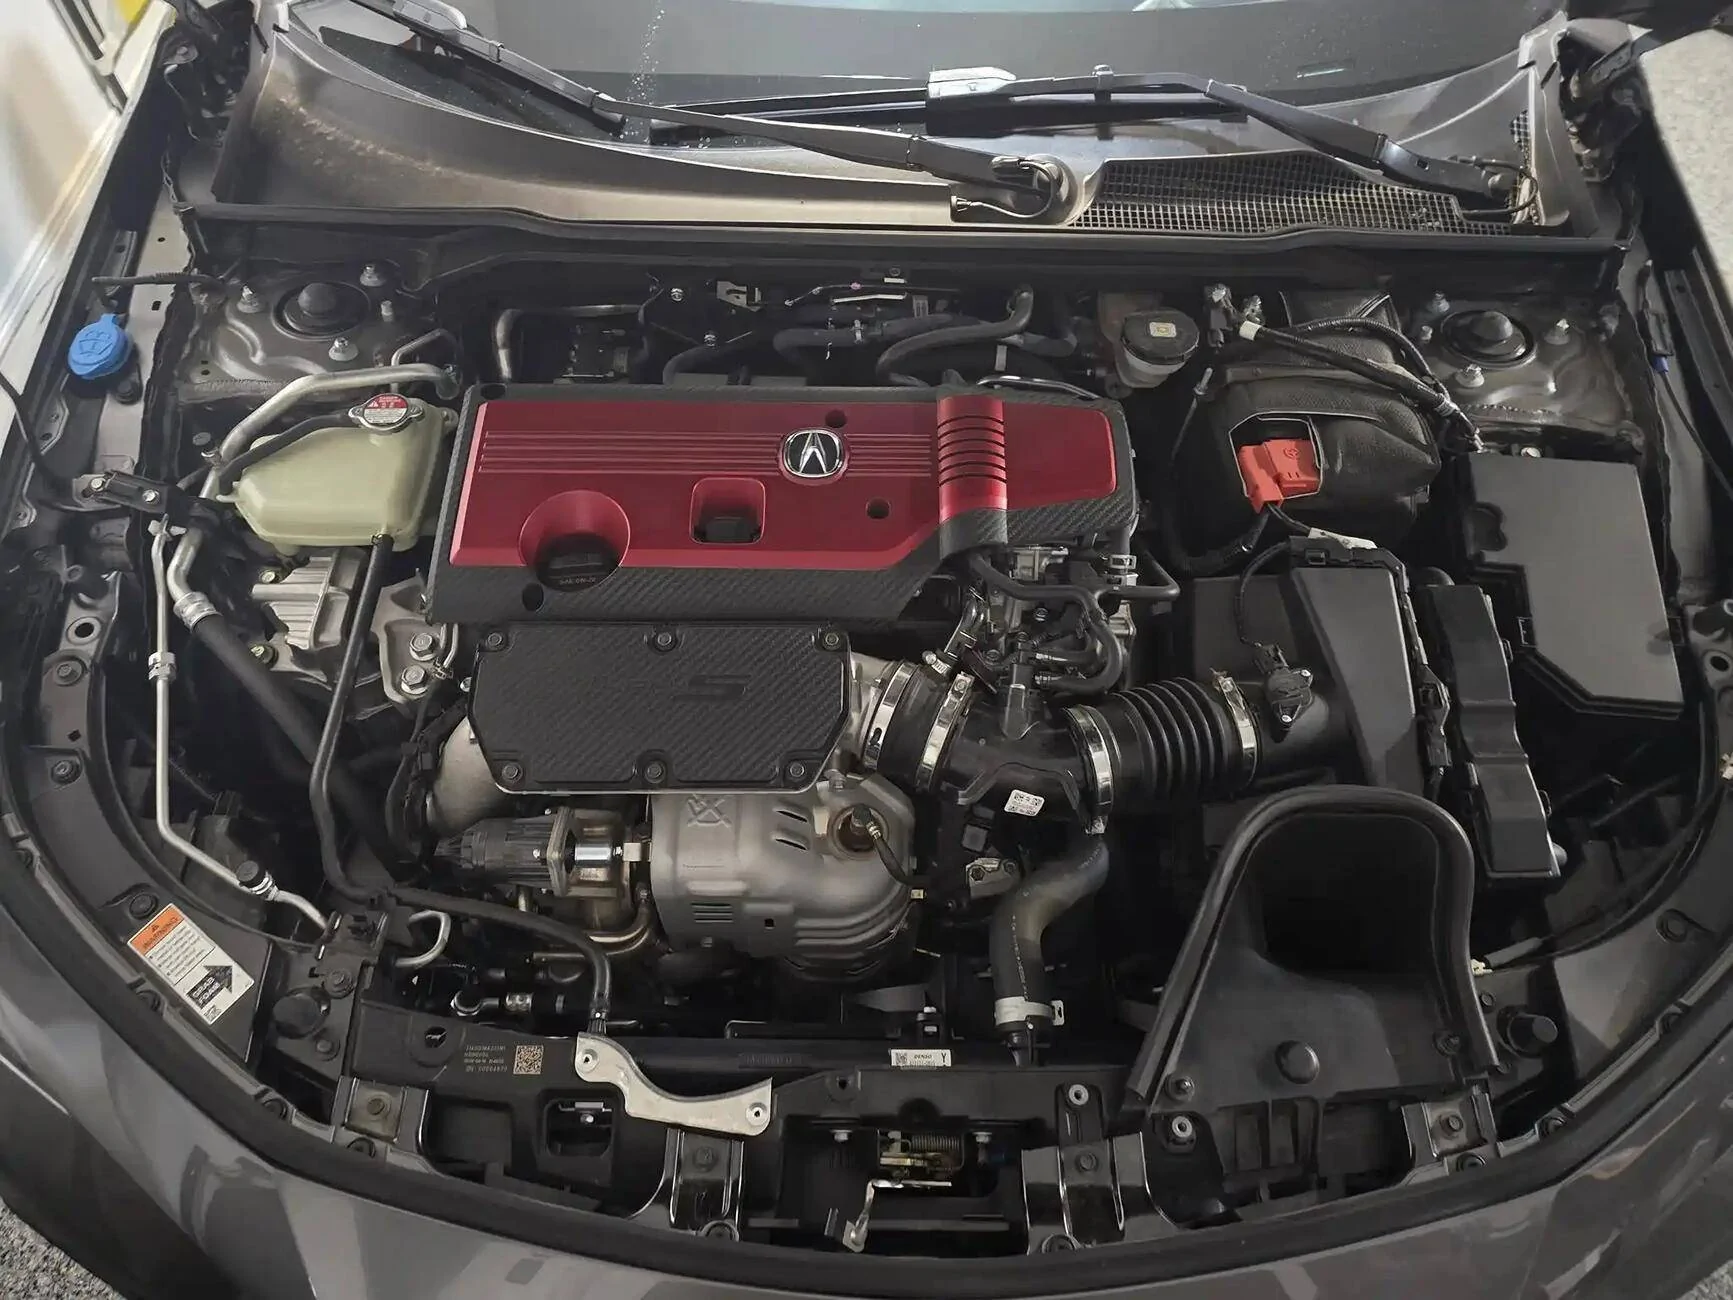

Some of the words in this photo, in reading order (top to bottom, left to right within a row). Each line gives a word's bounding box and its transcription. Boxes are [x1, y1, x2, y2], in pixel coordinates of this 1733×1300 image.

[192, 976, 215, 998] GRAB
[198, 982, 221, 1005] FOAM
[941, 1052, 947, 1063] Y
